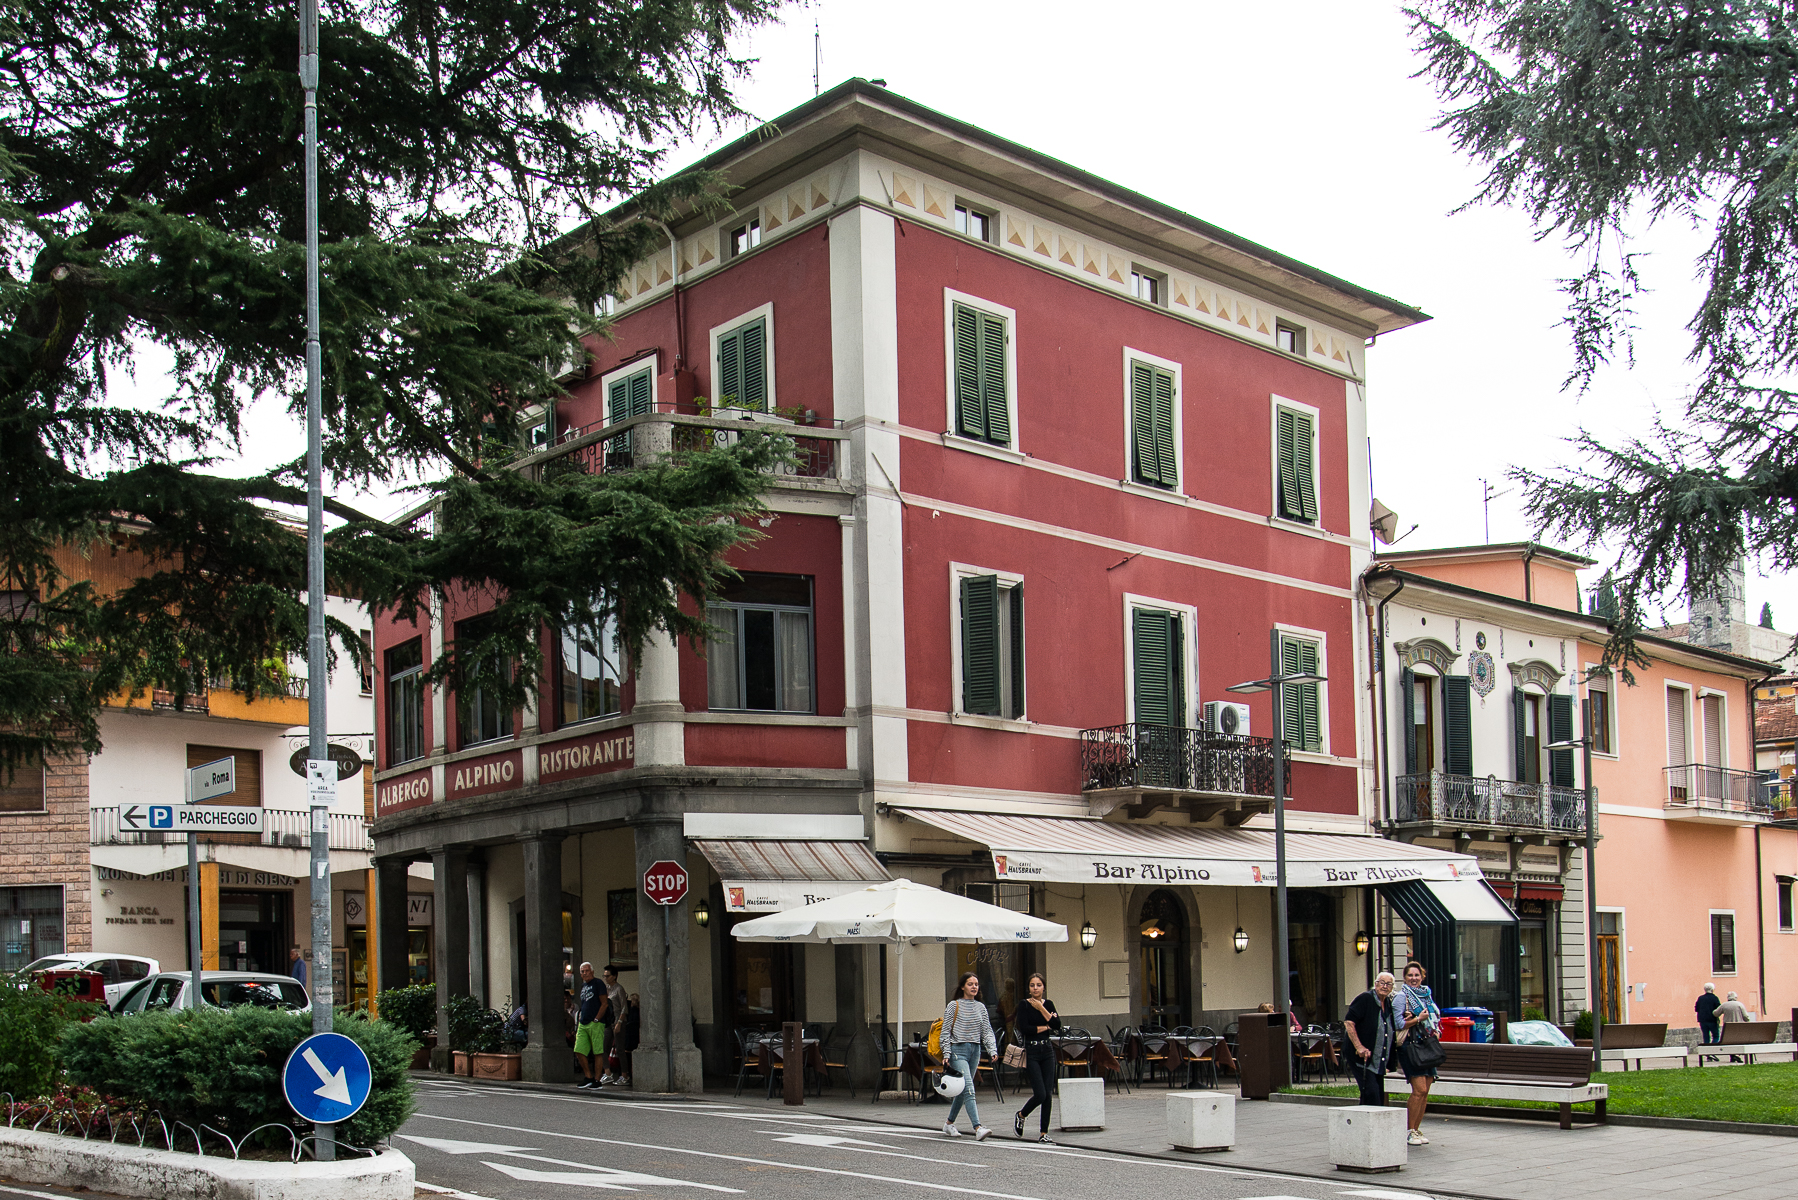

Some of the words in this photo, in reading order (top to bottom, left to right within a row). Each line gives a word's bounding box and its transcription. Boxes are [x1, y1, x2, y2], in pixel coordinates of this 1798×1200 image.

[540, 736, 634, 775] RISTORANTE
[299, 760, 354, 772] ANO
[212, 771, 230, 786] Roma
[454, 760, 514, 791] ALPINO
[380, 777, 429, 808] ALBERGO
[180, 811, 257, 825] PARCHEGGIO
[152, 870, 178, 882] DEI
[236, 872, 250, 884] DI
[255, 873, 295, 886] SIENA
[1093, 862, 1136, 879] Bar
[1141, 863, 1211, 883] Alpino
[1323, 868, 1358, 882] Bar
[1365, 867, 1423, 881] Alpino
[647, 874, 685, 891] STOP
[120, 906, 160, 916] BANCA
[1522, 901, 1542, 914] Ottica
[105, 917, 138, 925] FONDATA
